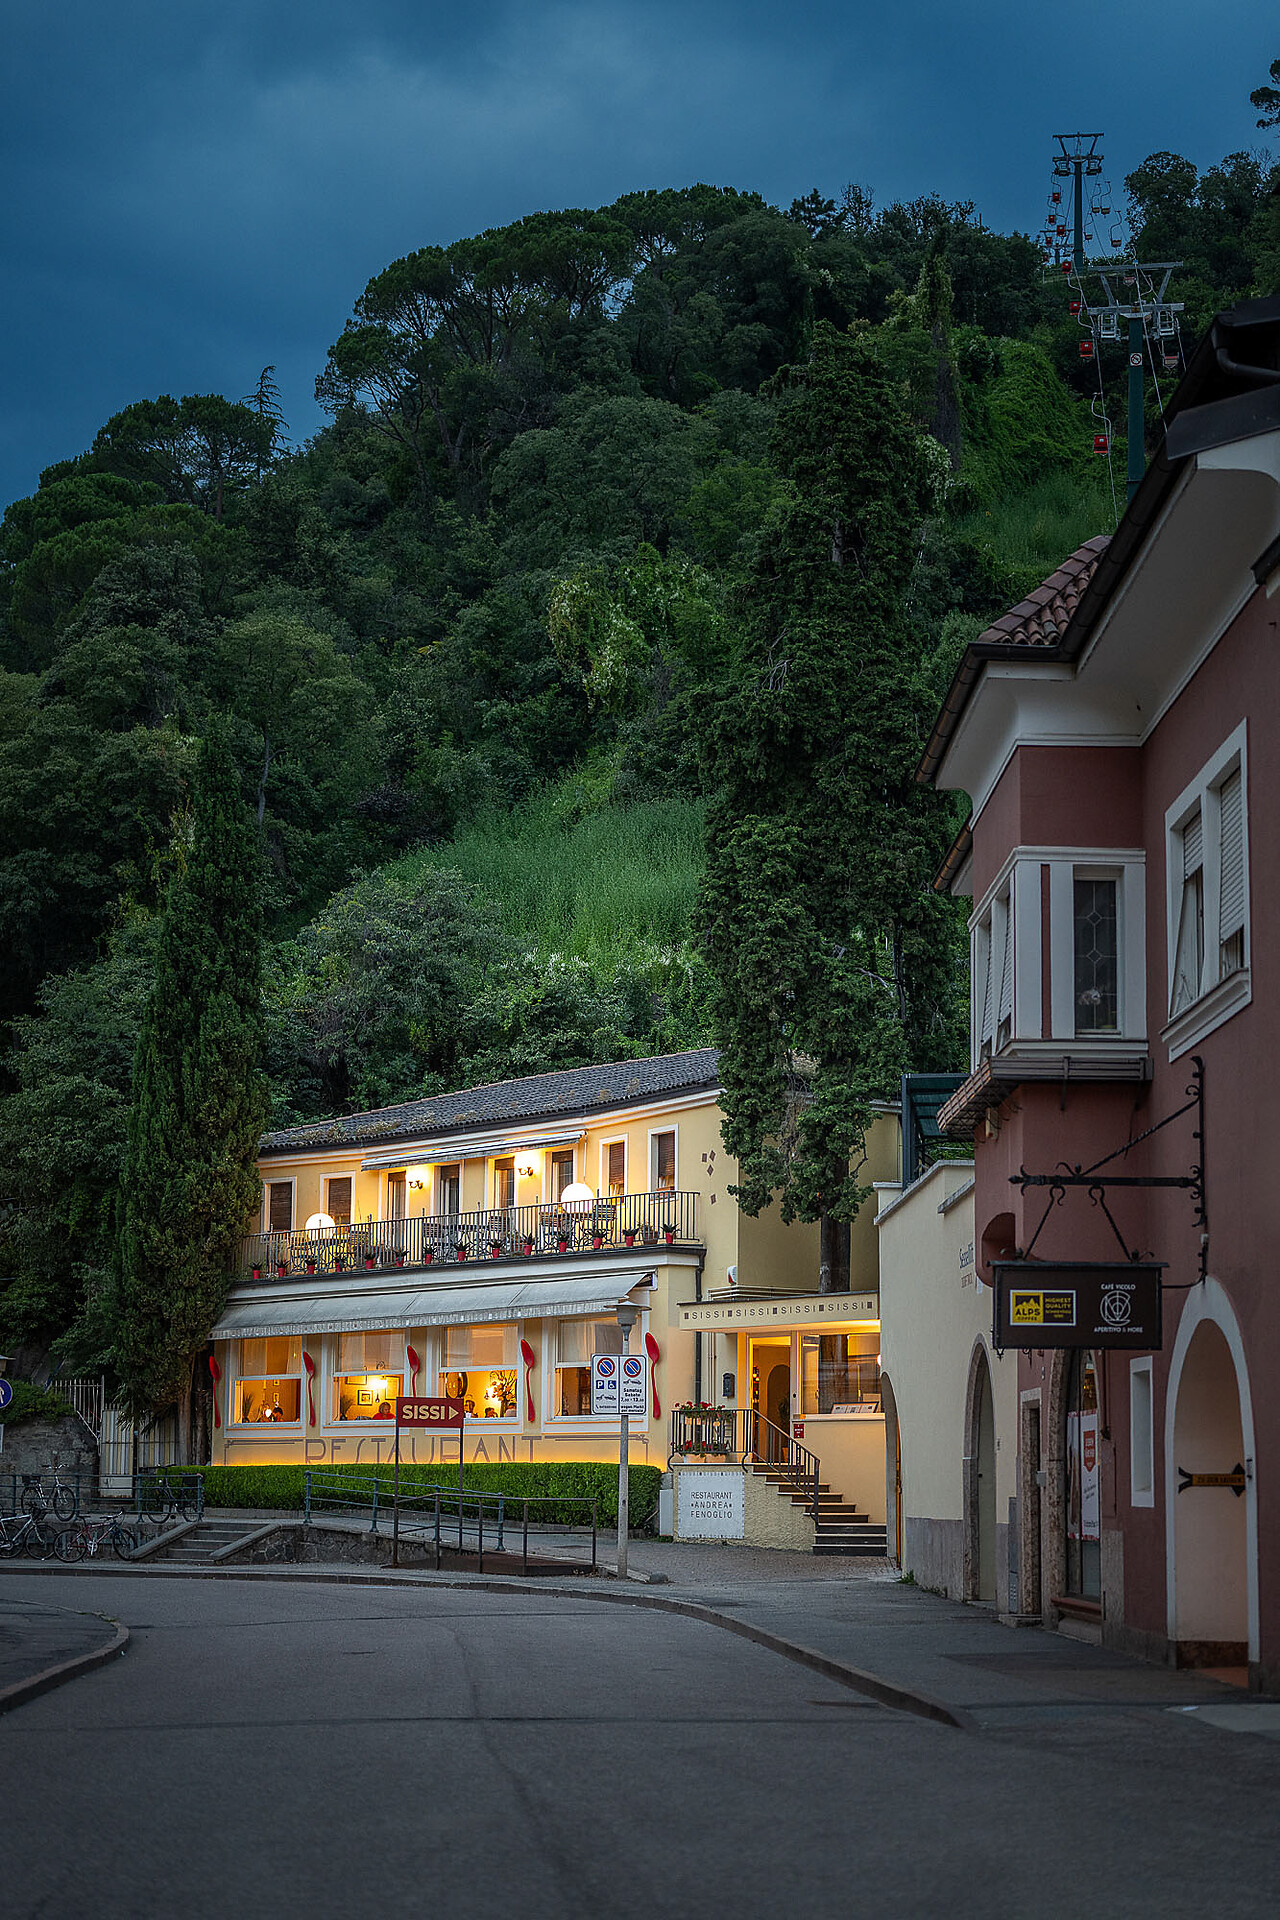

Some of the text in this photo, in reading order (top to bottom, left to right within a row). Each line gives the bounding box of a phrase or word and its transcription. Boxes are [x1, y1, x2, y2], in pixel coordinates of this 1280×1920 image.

[692, 1302, 864, 1319] SISSI SISSI SISSI SISSI
[1015, 1308, 1040, 1316] ALPS
[402, 1404, 446, 1420] SISSI
[305, 1435, 542, 1464] RESTAURANT
[691, 1492, 732, 1500] RESTAURANT
[691, 1510, 732, 1518] FENOGLIO
